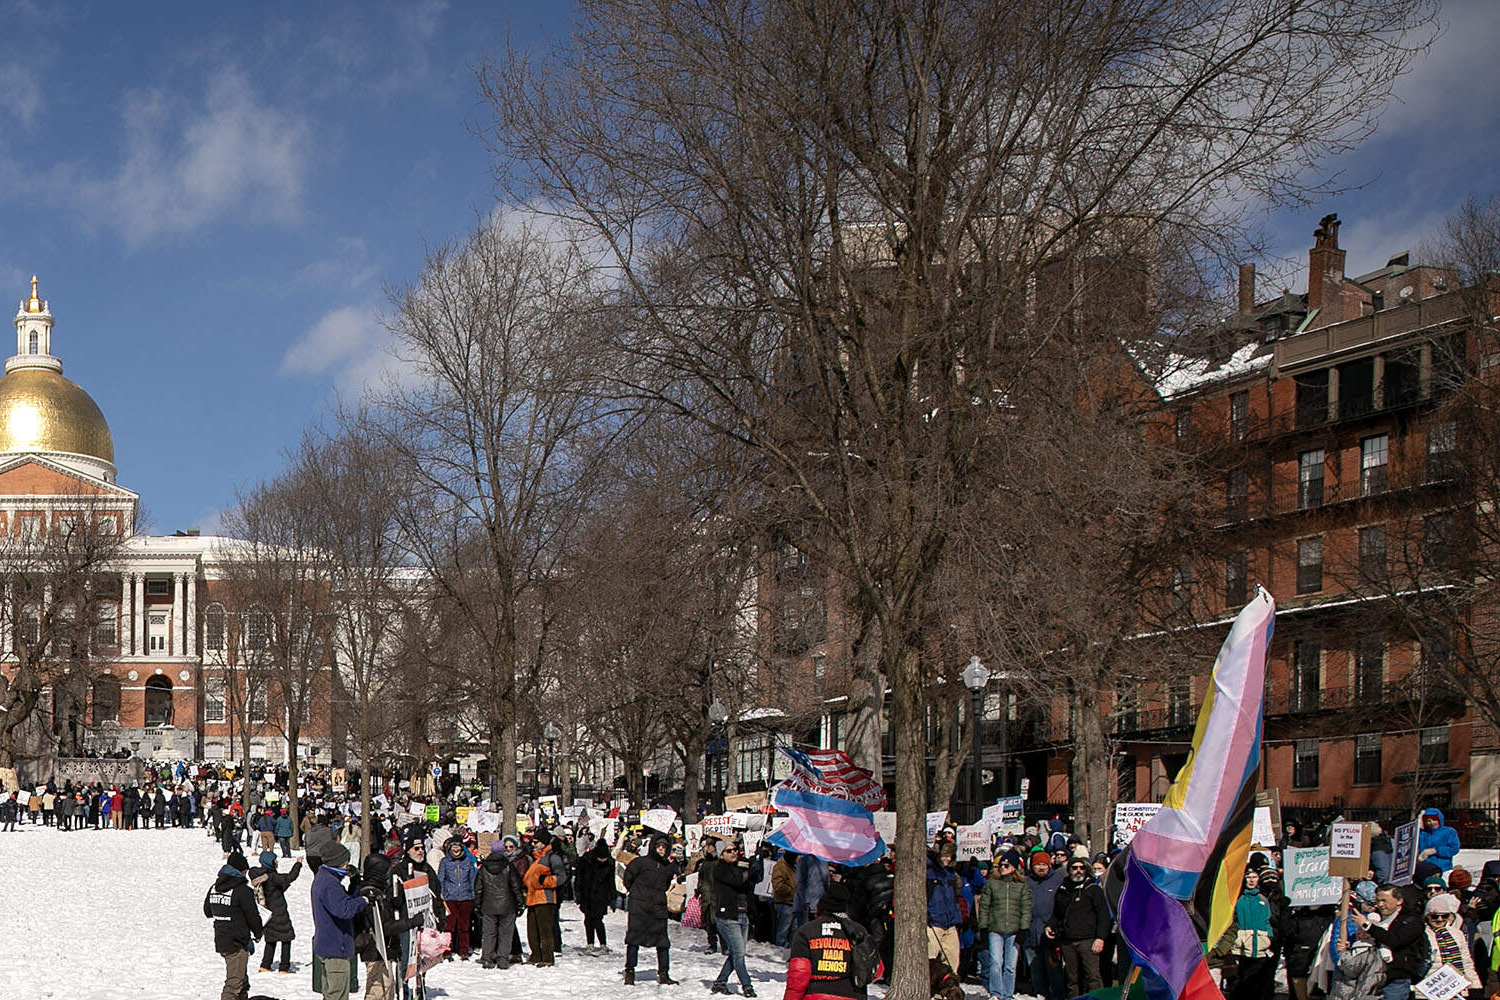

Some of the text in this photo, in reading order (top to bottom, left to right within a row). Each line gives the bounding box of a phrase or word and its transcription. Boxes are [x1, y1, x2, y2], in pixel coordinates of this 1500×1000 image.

[704, 816, 731, 825] RESIST
[962, 847, 987, 855] MUSK
[823, 949, 844, 960] NADA
[818, 960, 847, 973] MENOS!
[1426, 971, 1448, 988] SAVE
